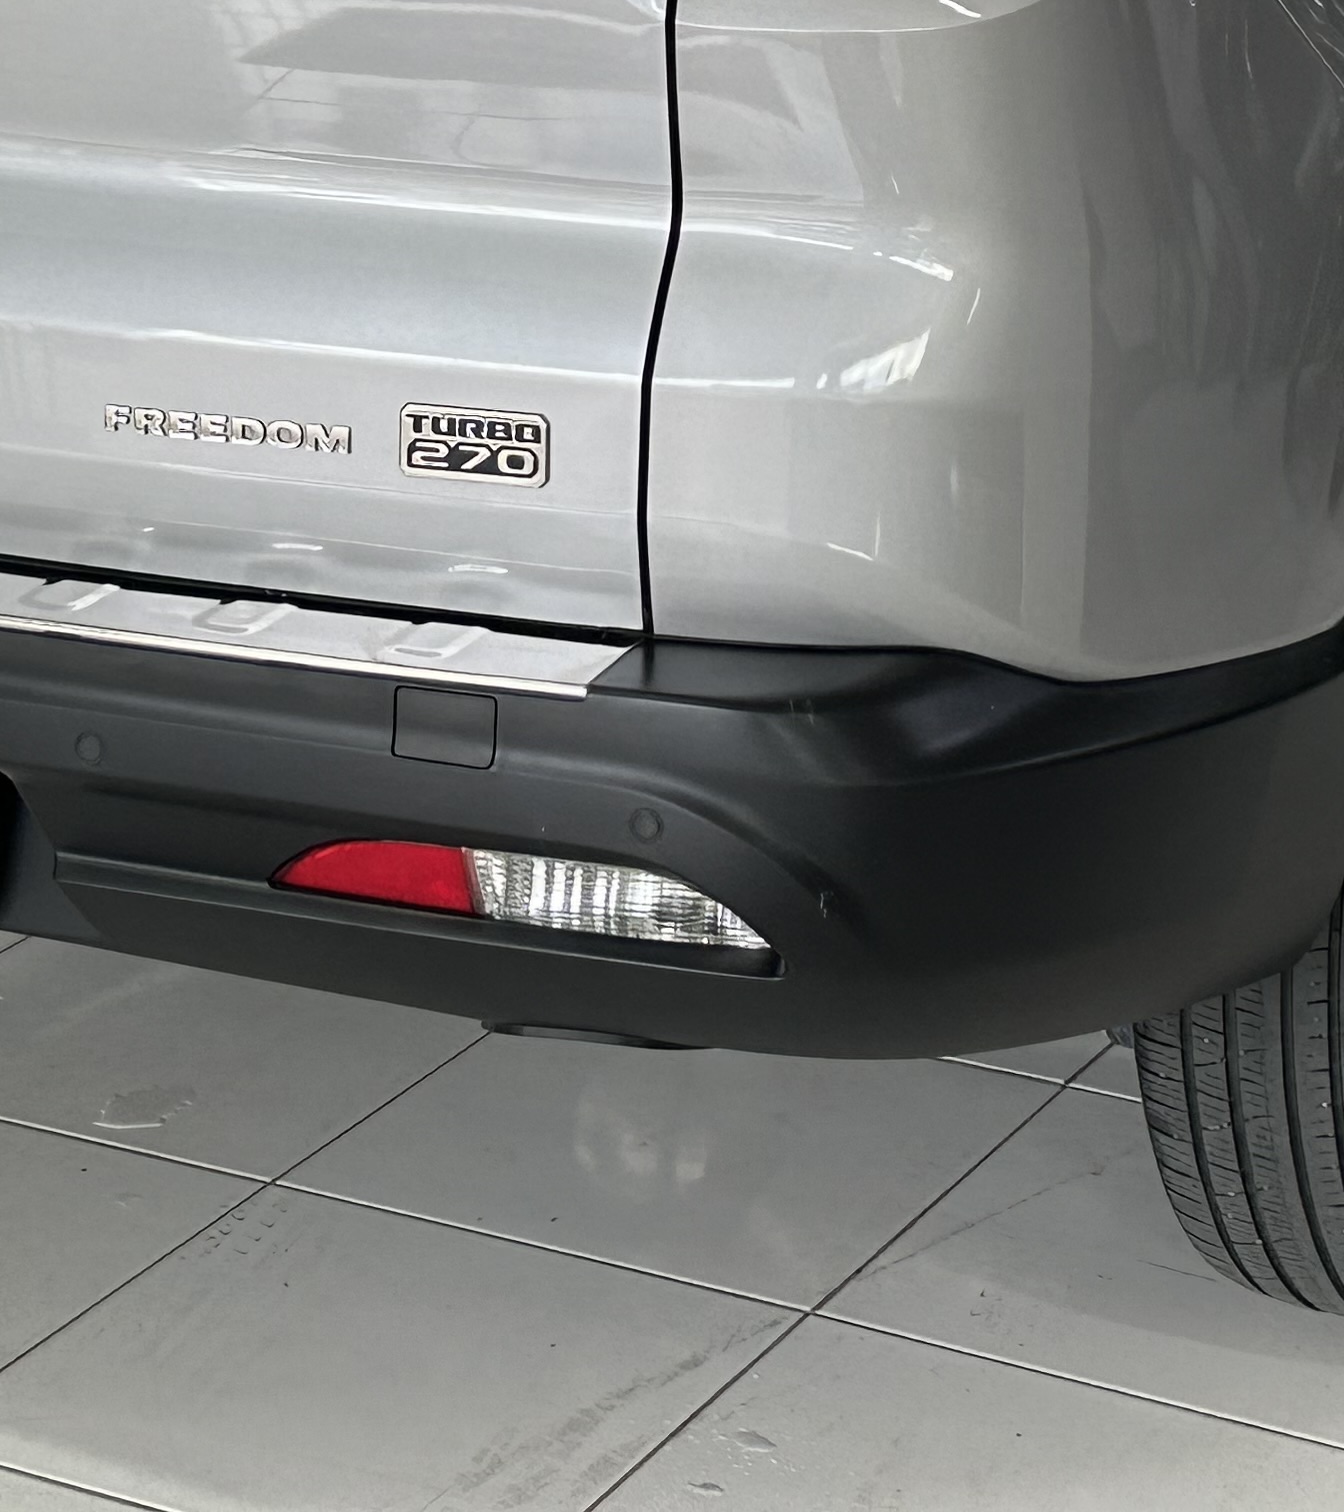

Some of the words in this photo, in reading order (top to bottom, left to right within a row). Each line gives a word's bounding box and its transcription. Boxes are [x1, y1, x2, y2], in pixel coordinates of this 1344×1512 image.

[103, 402, 353, 456] FREEDOM
[406, 412, 541, 445] TURBO
[410, 438, 537, 477] 270
